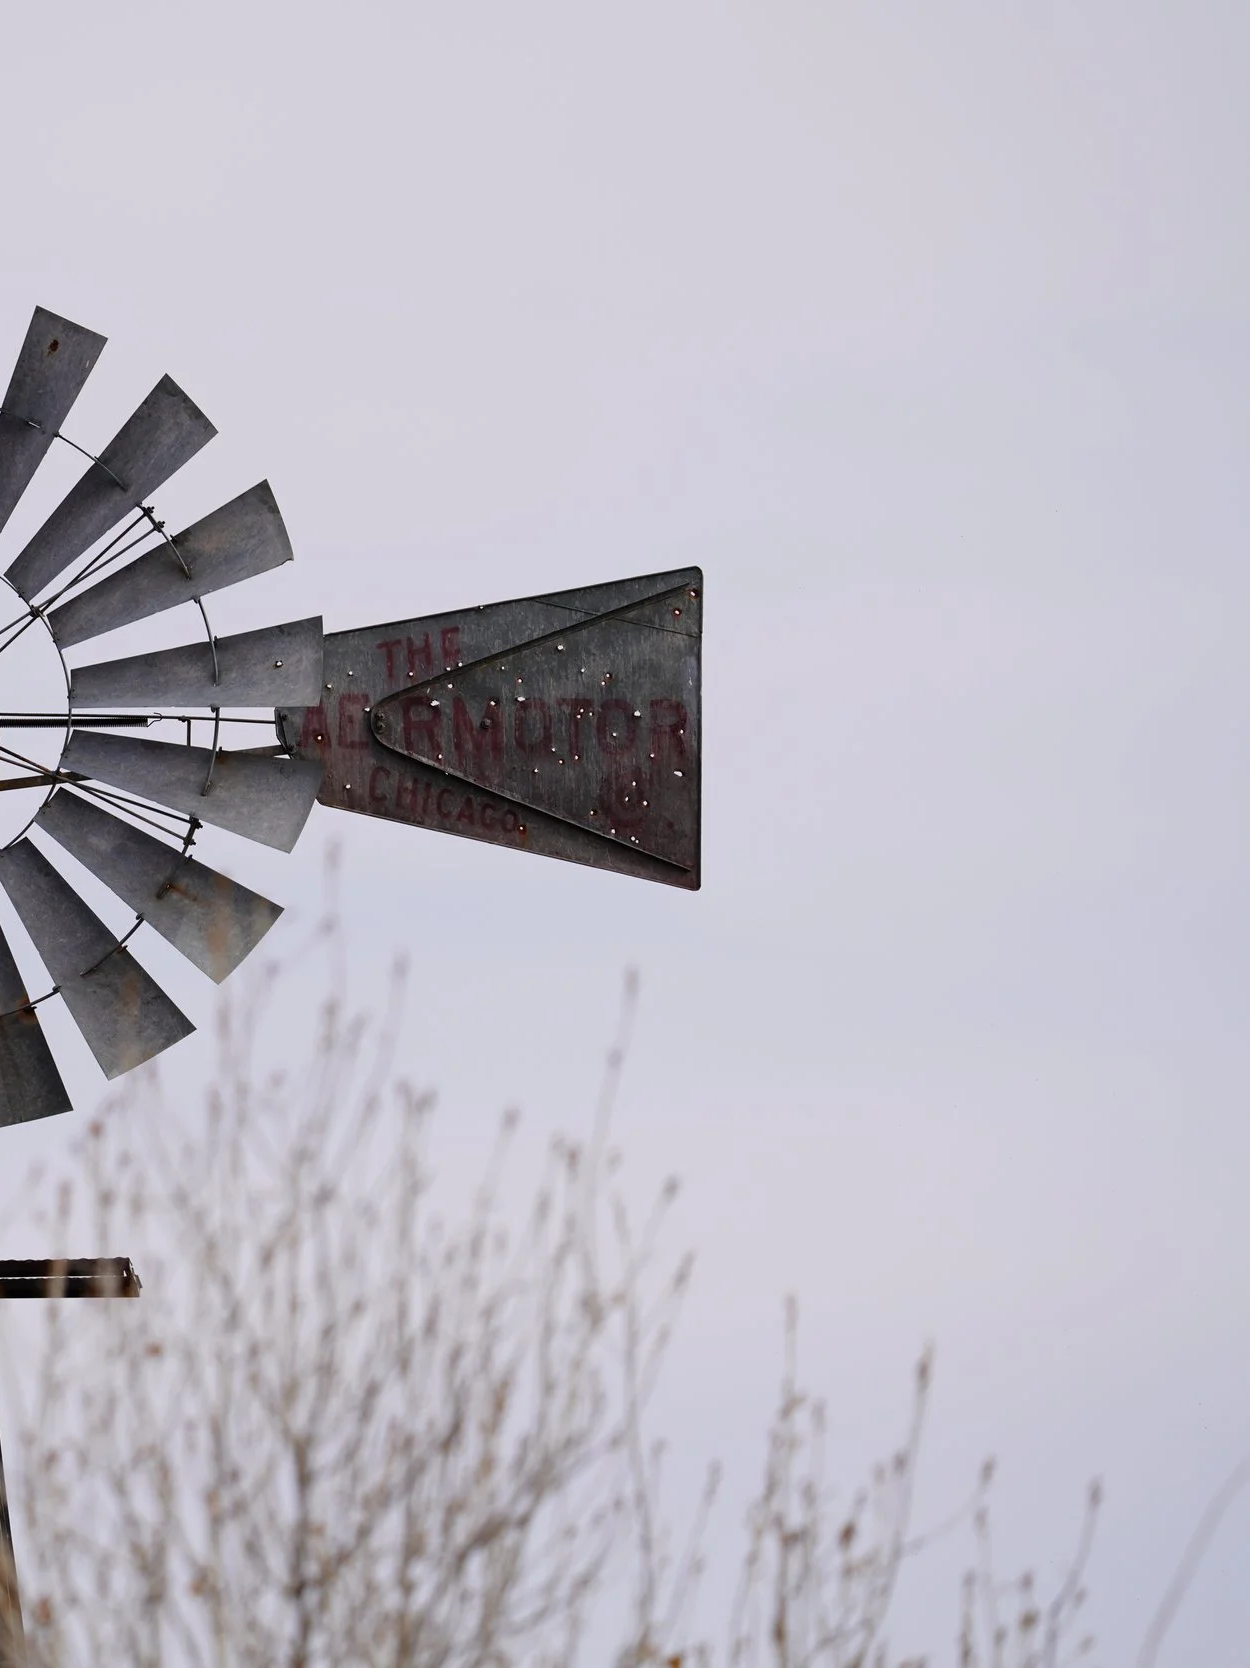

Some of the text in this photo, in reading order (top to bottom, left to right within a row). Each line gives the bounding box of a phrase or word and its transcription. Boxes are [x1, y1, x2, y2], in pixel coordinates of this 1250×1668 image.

[376, 626, 461, 680] THE
[298, 692, 689, 774] AERMOTOR
[370, 766, 520, 833] CHICAGO
